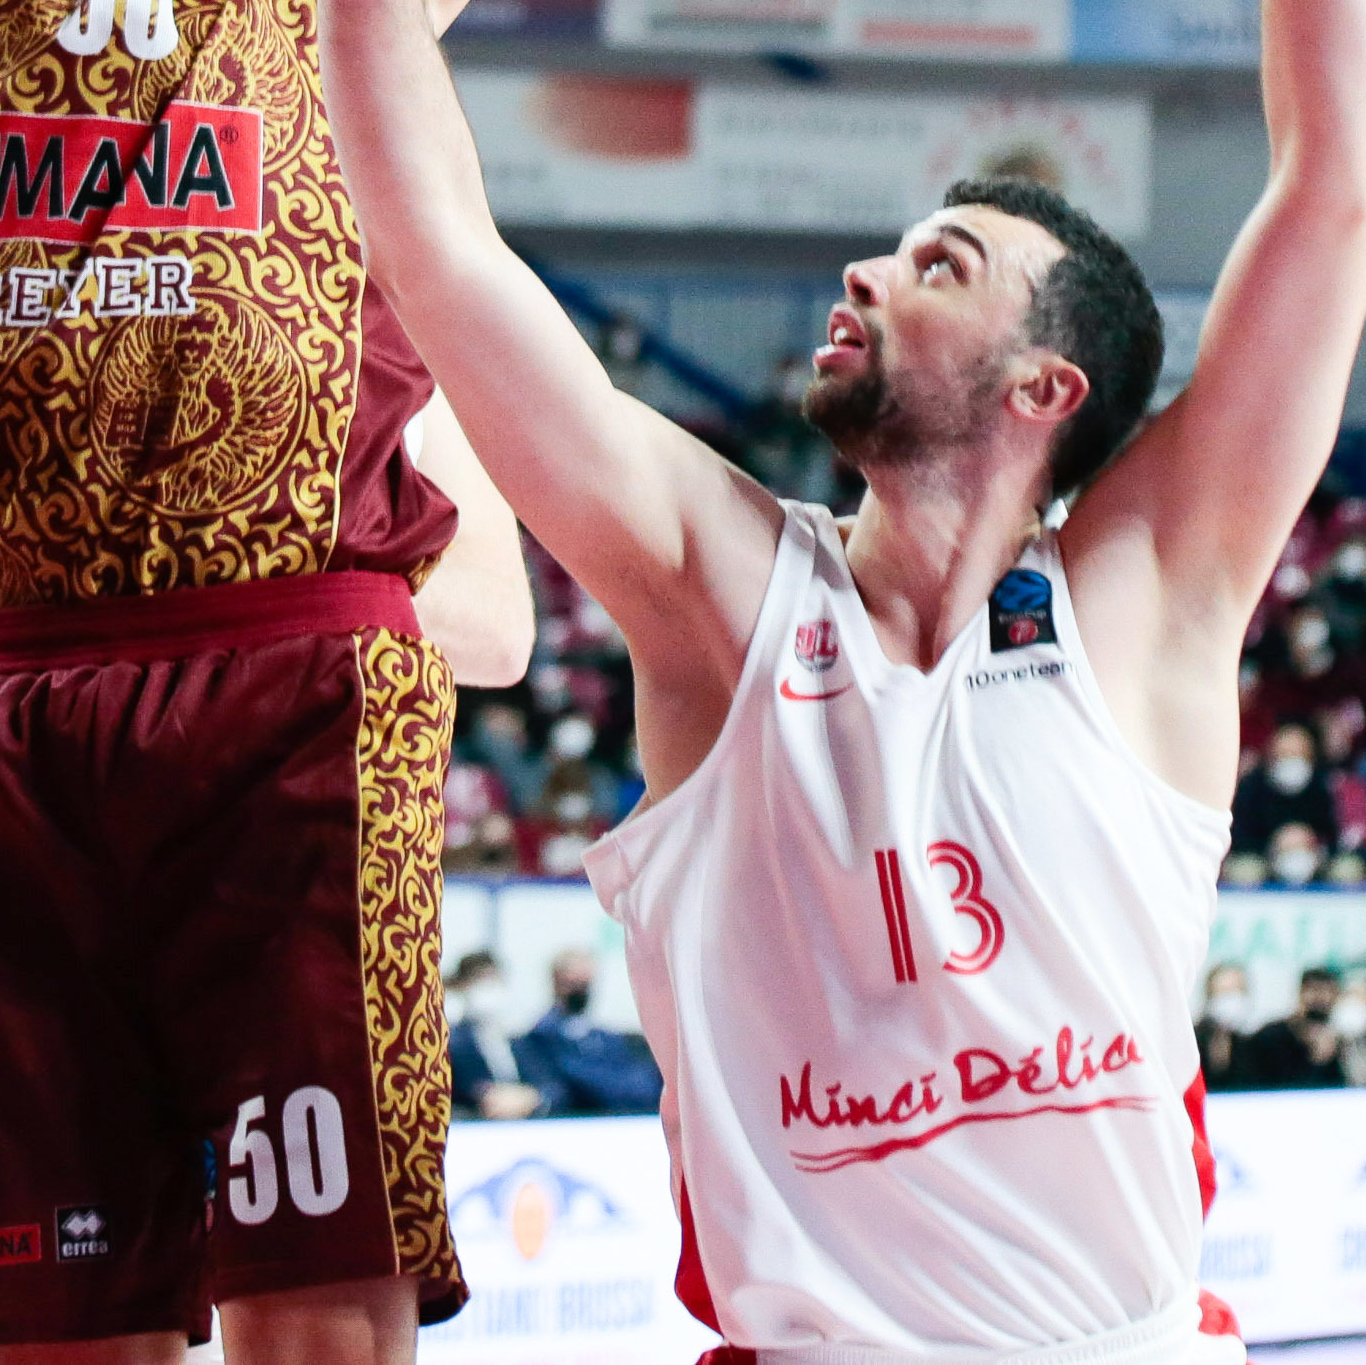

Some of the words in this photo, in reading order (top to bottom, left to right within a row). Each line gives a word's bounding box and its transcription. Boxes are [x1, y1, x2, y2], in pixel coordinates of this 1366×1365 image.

[874, 840, 1005, 985] 13
[228, 1085, 350, 1226] 50
[780, 1060, 943, 1130] Minci
